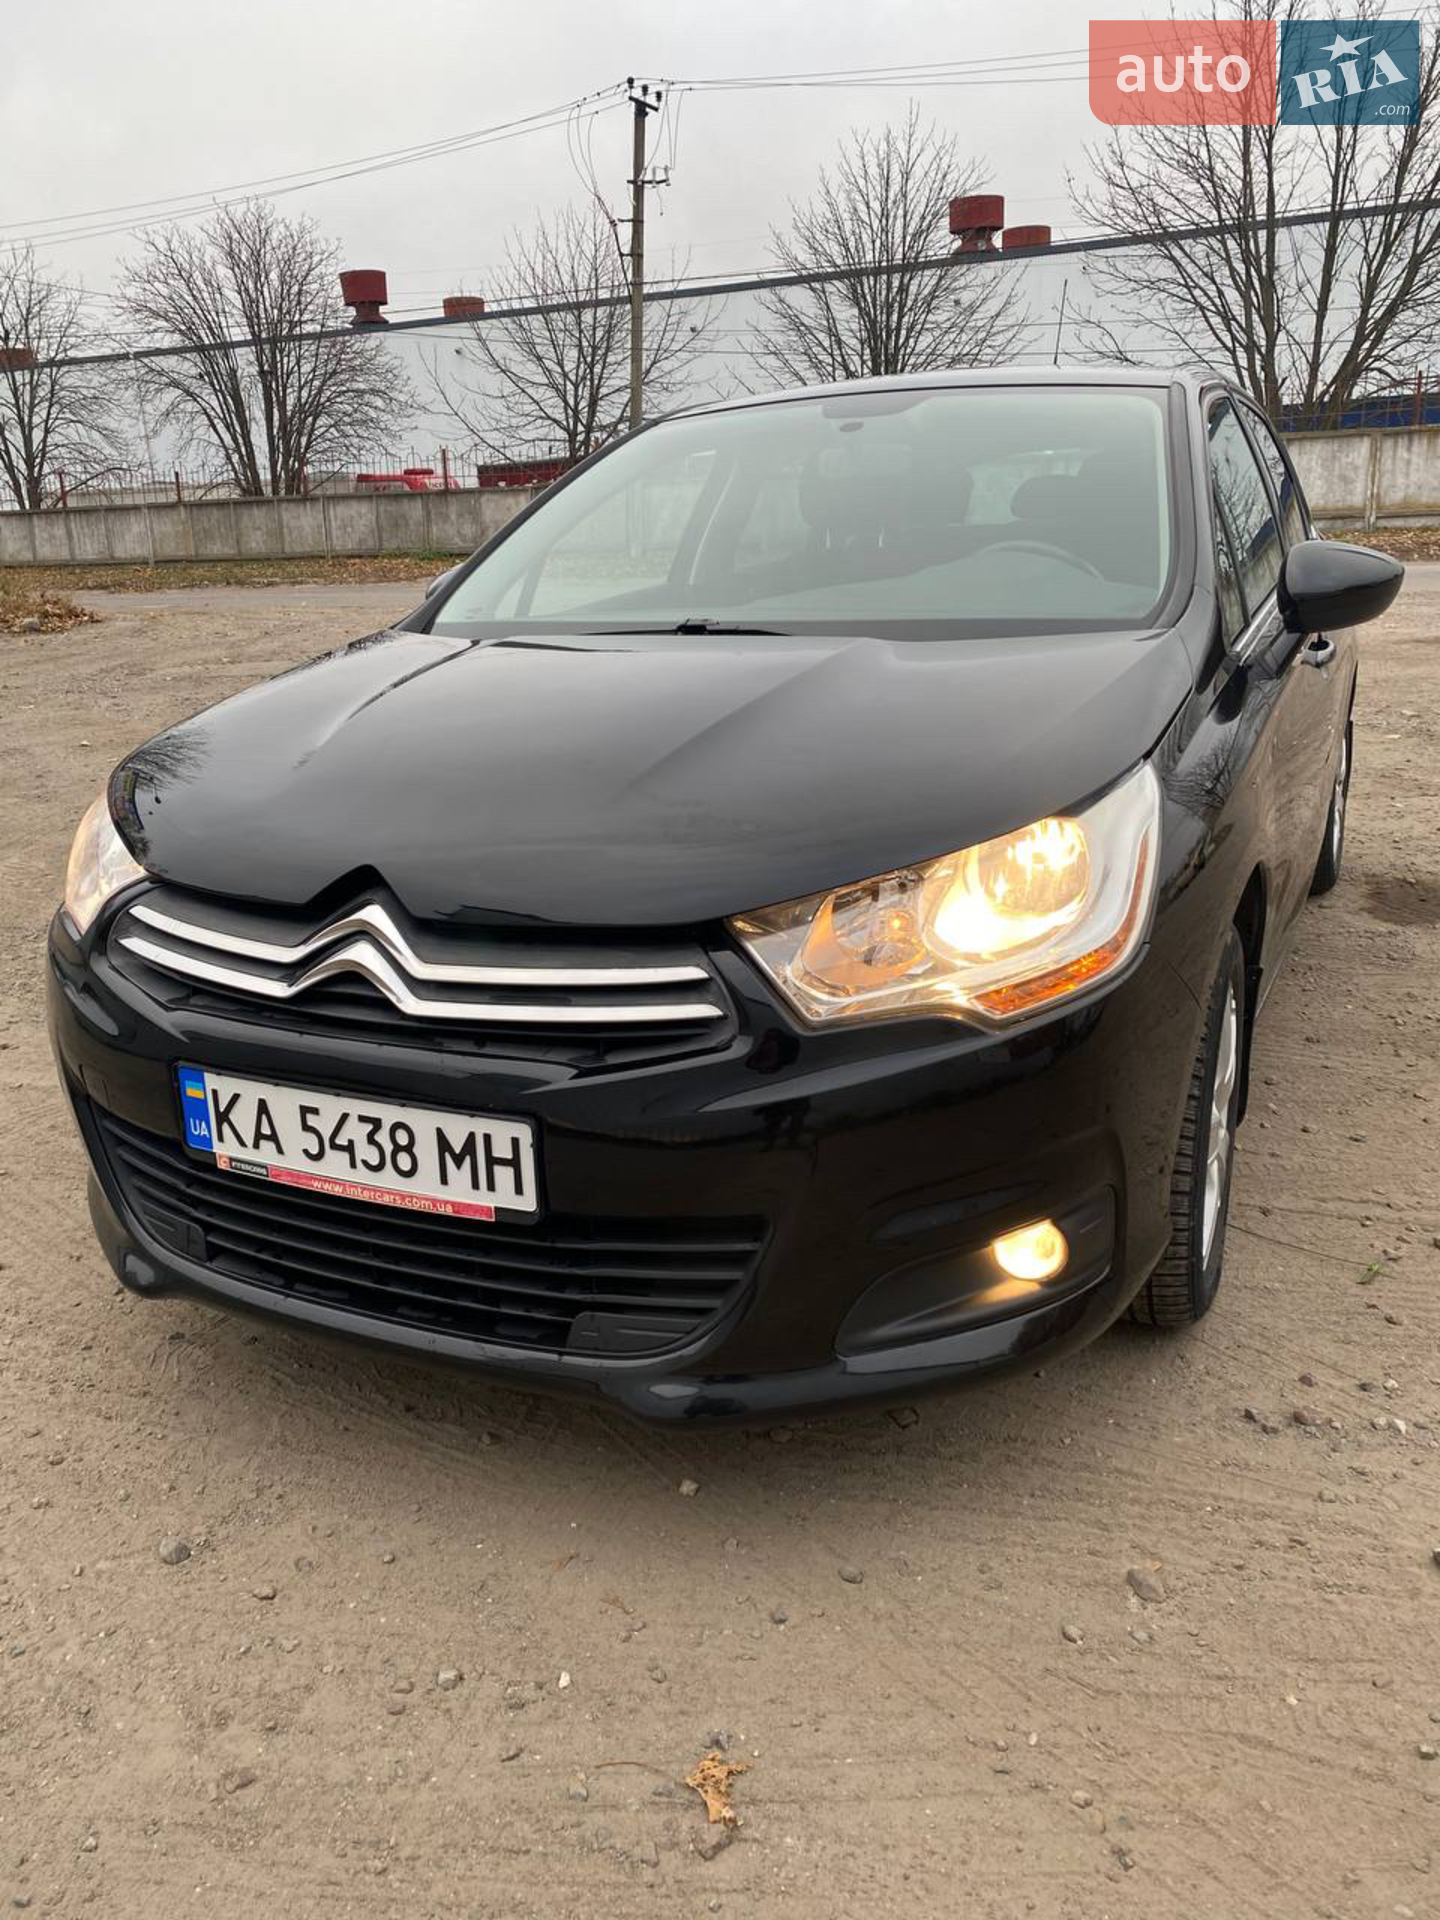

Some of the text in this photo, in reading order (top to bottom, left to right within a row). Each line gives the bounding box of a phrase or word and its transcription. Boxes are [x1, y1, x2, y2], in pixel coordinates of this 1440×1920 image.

[190, 1117, 210, 1137] UA
[211, 1088, 524, 1196] KA 5438 MH
[311, 1178, 453, 1213] www.intercars.com.ua
